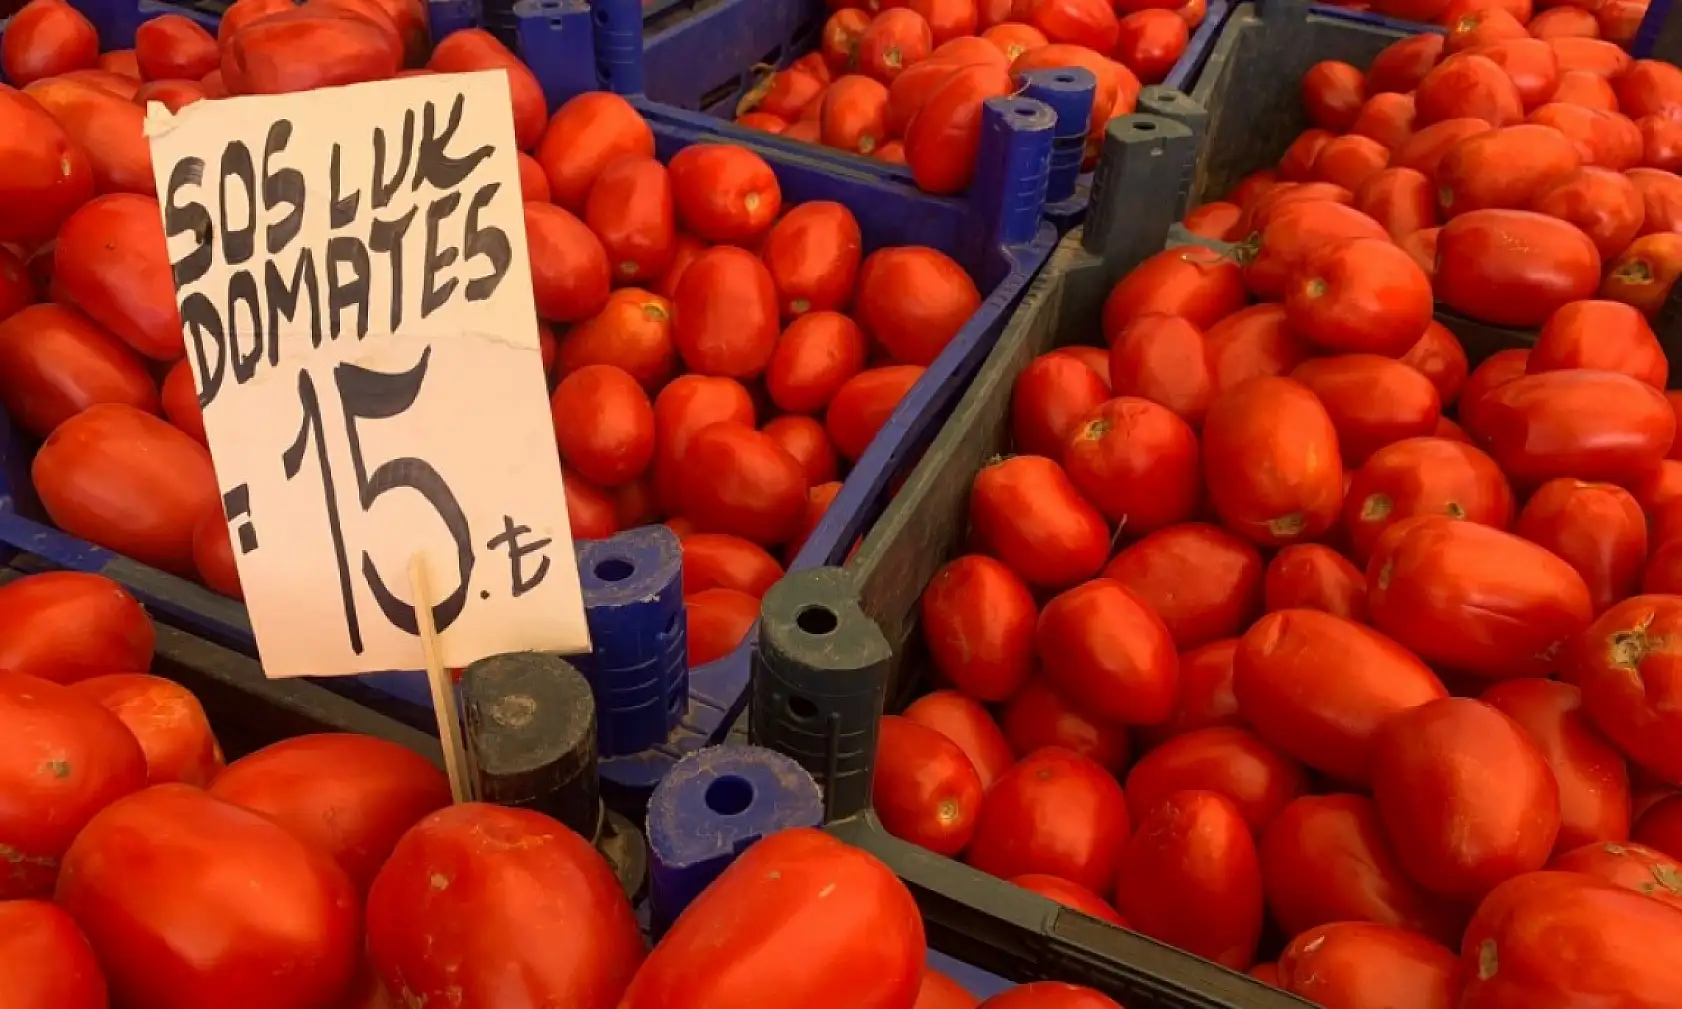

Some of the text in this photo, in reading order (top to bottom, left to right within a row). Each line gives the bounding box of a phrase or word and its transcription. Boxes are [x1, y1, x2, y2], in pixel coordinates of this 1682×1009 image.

[166, 93, 495, 285] SOS LUK
[180, 182, 512, 408] DOMATES
